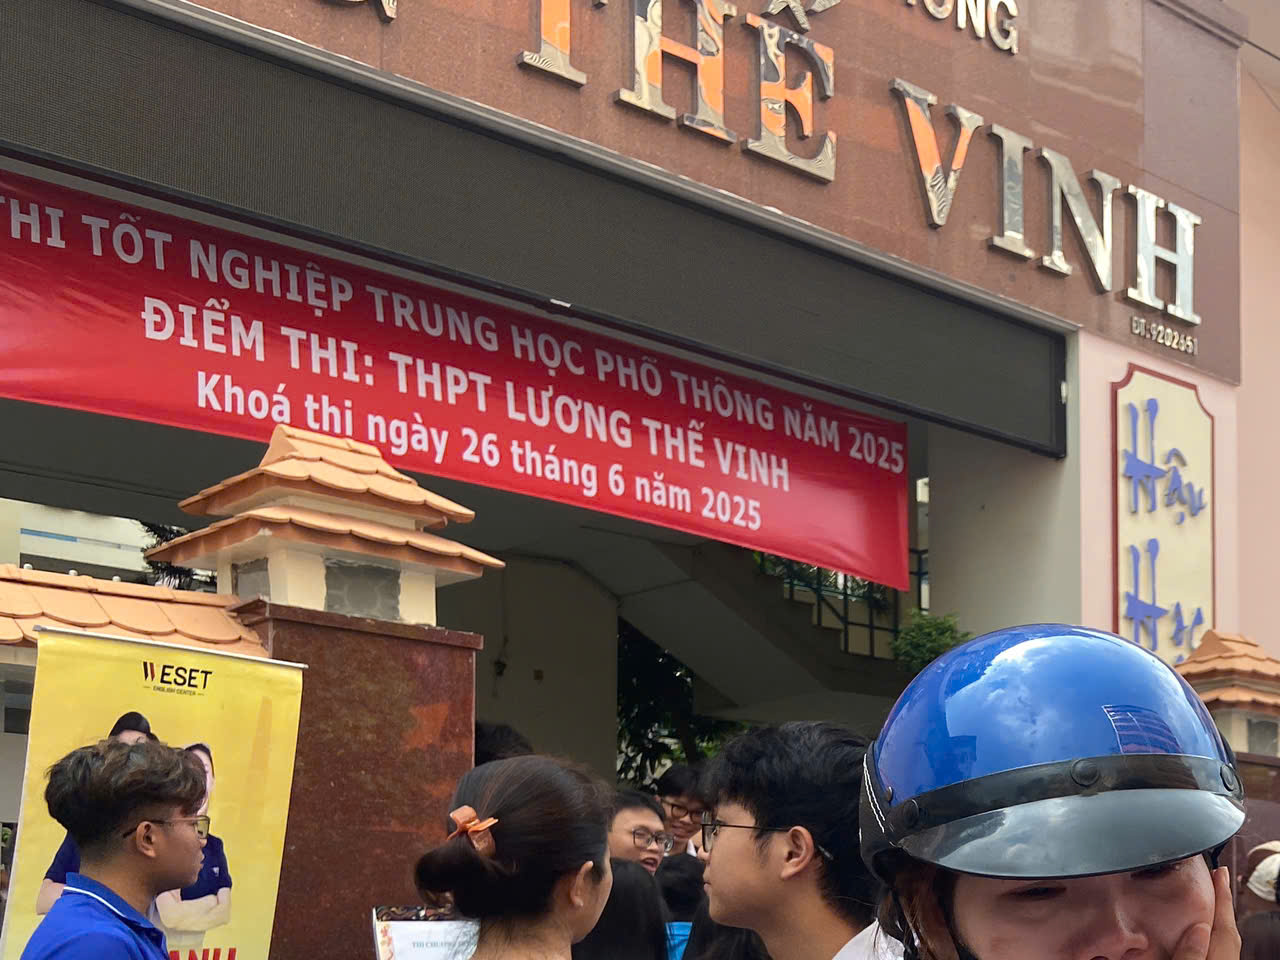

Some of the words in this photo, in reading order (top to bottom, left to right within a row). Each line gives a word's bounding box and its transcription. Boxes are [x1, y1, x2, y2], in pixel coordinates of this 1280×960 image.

[891, 78, 1203, 326] VINH
[0, 196, 66, 249] HI
[190, 239, 353, 317] NGHIỆP
[365, 285, 498, 351] TRUNG
[510, 325, 585, 376] HỌC
[671, 370, 773, 430] THÔNG
[782, 403, 840, 452] NĂM
[849, 427, 904, 474] 2025
[141, 297, 265, 361] ĐIỂM
[281, 326, 374, 386] THI:
[389, 351, 492, 412] THPT
[505, 381, 632, 448] LƯƠNG
[641, 418, 705, 468] THẾ
[713, 437, 790, 492] VINH
[197, 371, 291, 424] Khoá
[305, 393, 353, 436] thi
[367, 412, 448, 464] ngày
[461, 428, 500, 467] 26
[511, 439, 597, 497] tháng
[608, 464, 625, 496] 6
[635, 472, 691, 513] năm
[701, 487, 762, 531] 2025
